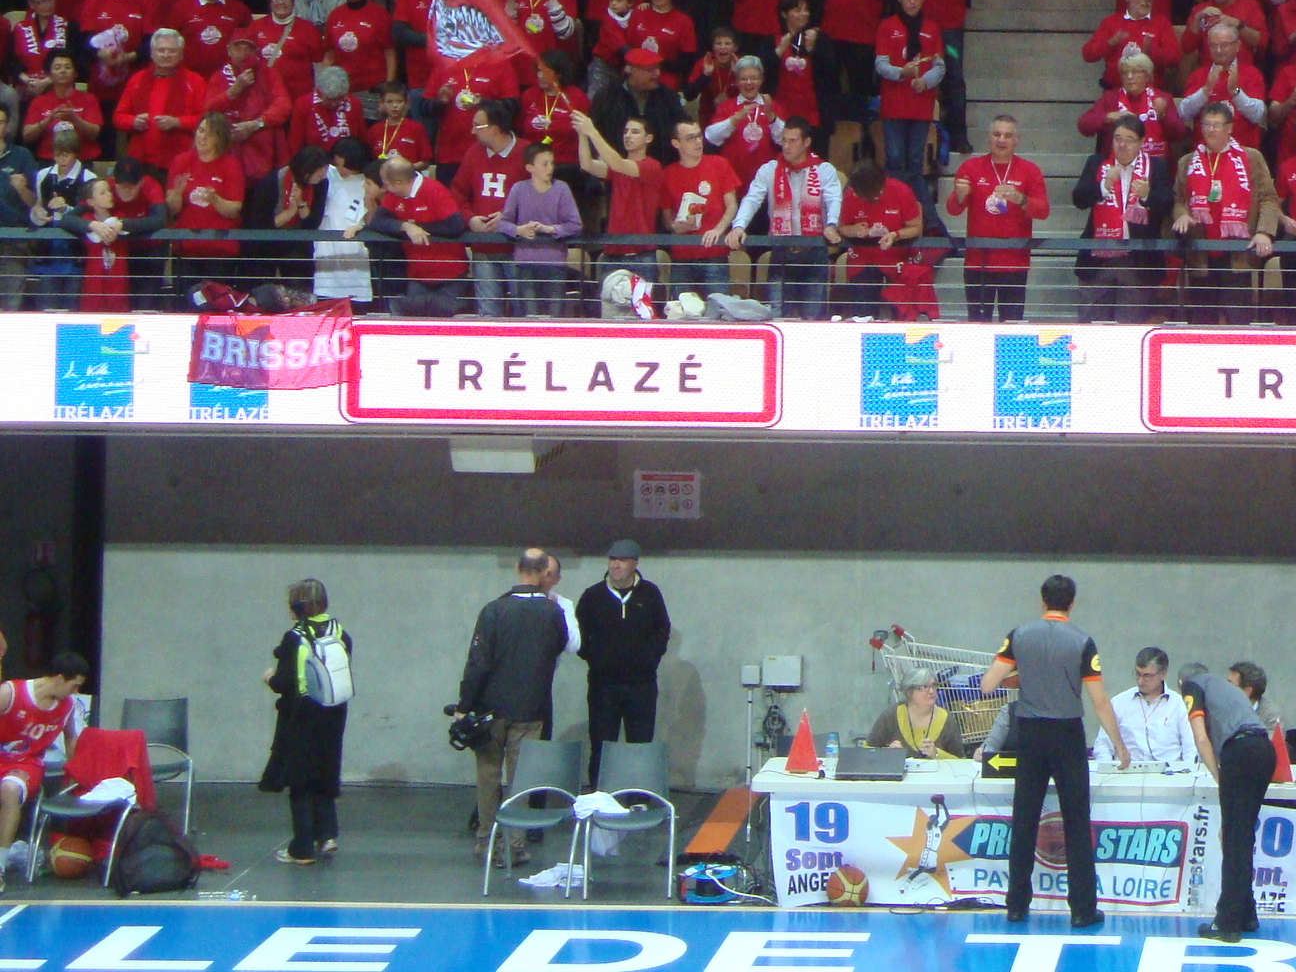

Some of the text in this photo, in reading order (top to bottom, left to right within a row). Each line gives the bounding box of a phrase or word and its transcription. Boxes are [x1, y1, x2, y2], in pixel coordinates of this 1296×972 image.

[482, 172, 506, 198] H
[202, 329, 355, 370] BRISSAC
[416, 352, 703, 393] TRÉLAZÉ
[54, 403, 134, 420] TRÉLAZÉ
[189, 404, 269, 421] TRÉLAZÉ
[859, 410, 938, 428] TRÉLAZÉ
[993, 412, 1072, 429] TRÉLAZÉ
[784, 801, 850, 845] 19
[1253, 815, 1295, 859] 0
[969, 822, 1182, 864] PR STARS
[787, 872, 832, 896] ANGE
[1039, 872, 1068, 892] DE
[1112, 877, 1172, 900] LOIRE
[494, 928, 872, 972] DE
